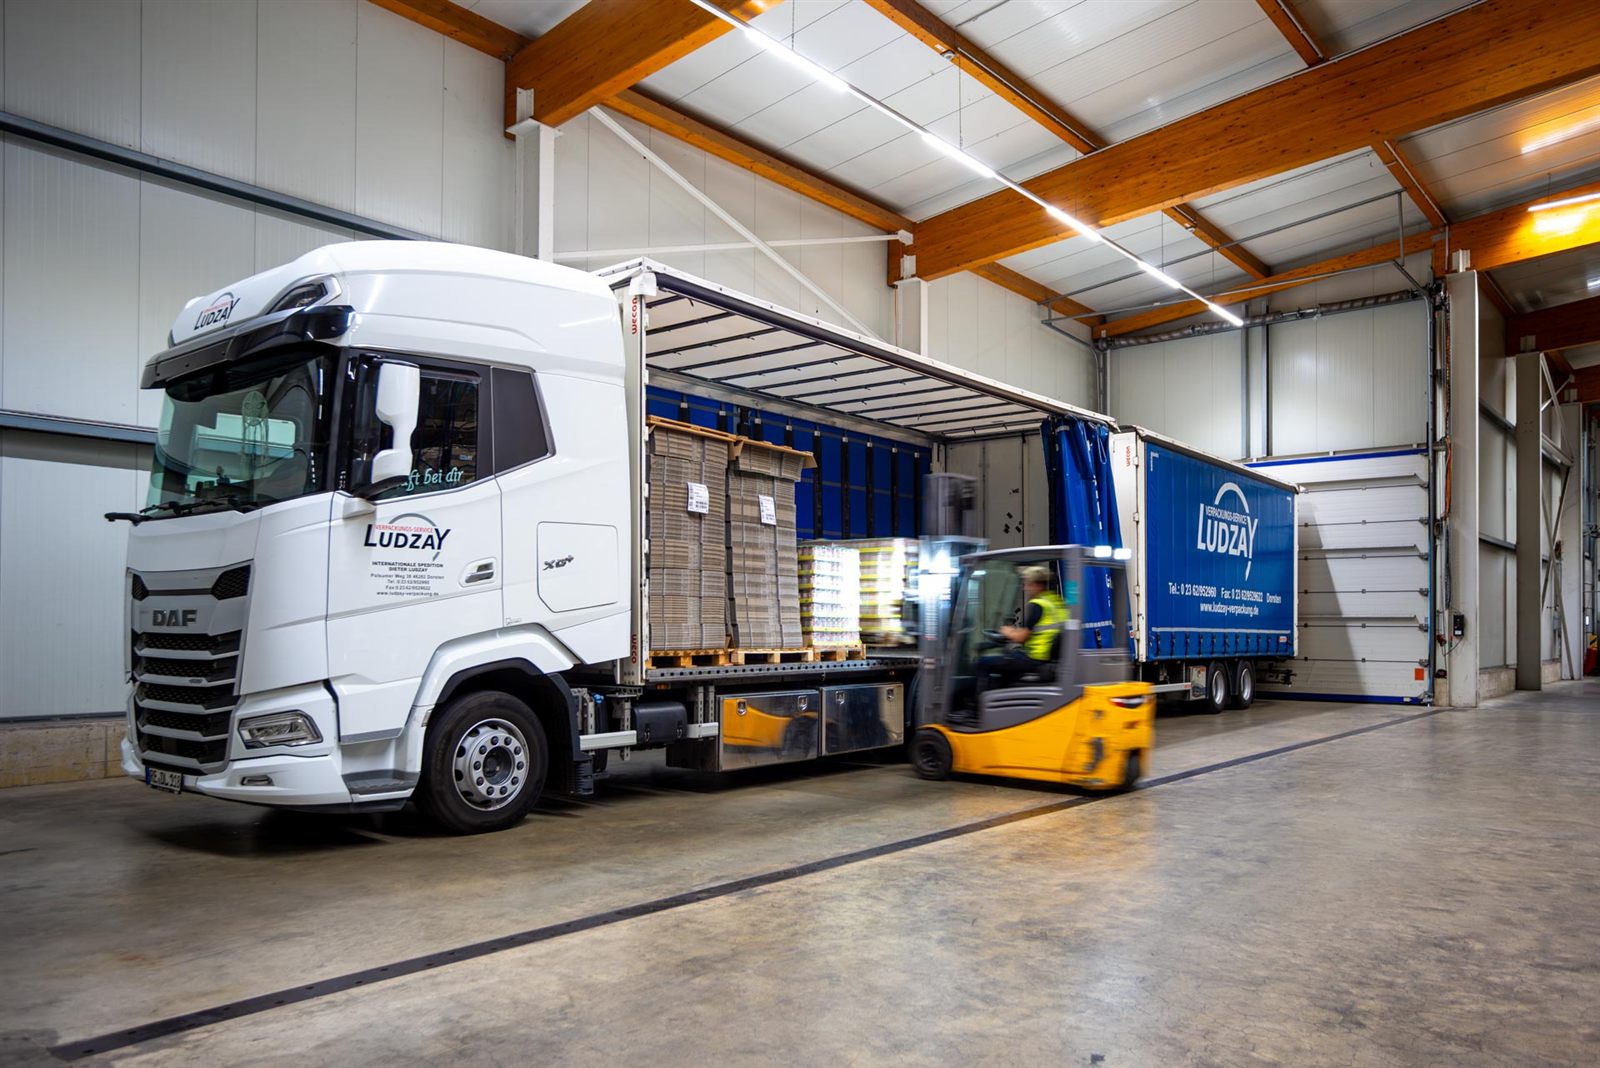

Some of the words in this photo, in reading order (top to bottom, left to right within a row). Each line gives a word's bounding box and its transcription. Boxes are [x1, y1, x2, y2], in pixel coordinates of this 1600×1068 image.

[193, 297, 240, 330] LUDZAY
[424, 467, 442, 484] bei
[445, 466, 464, 482] dir
[364, 523, 452, 550] LUDZAY
[1197, 503, 1258, 558] LUDZAY
[152, 608, 198, 626] DAF
